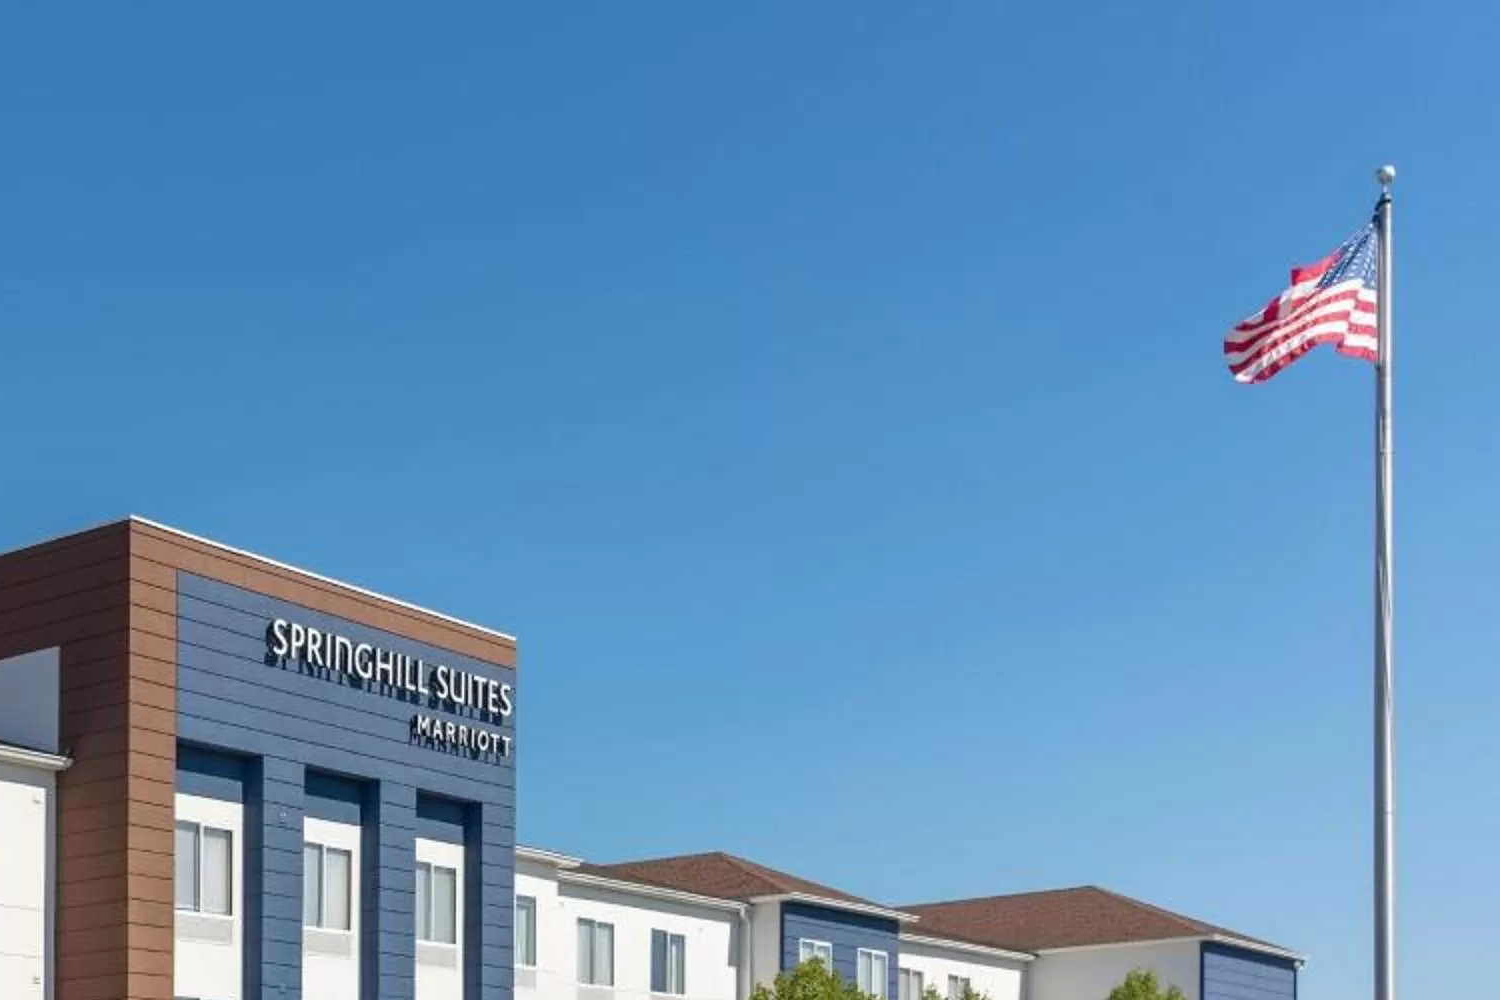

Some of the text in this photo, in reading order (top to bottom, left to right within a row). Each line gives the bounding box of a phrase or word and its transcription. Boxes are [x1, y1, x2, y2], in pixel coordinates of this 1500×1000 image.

[272, 619, 513, 716] SPRINGHILL SUITES
[416, 714, 512, 757] MARRIOTT
